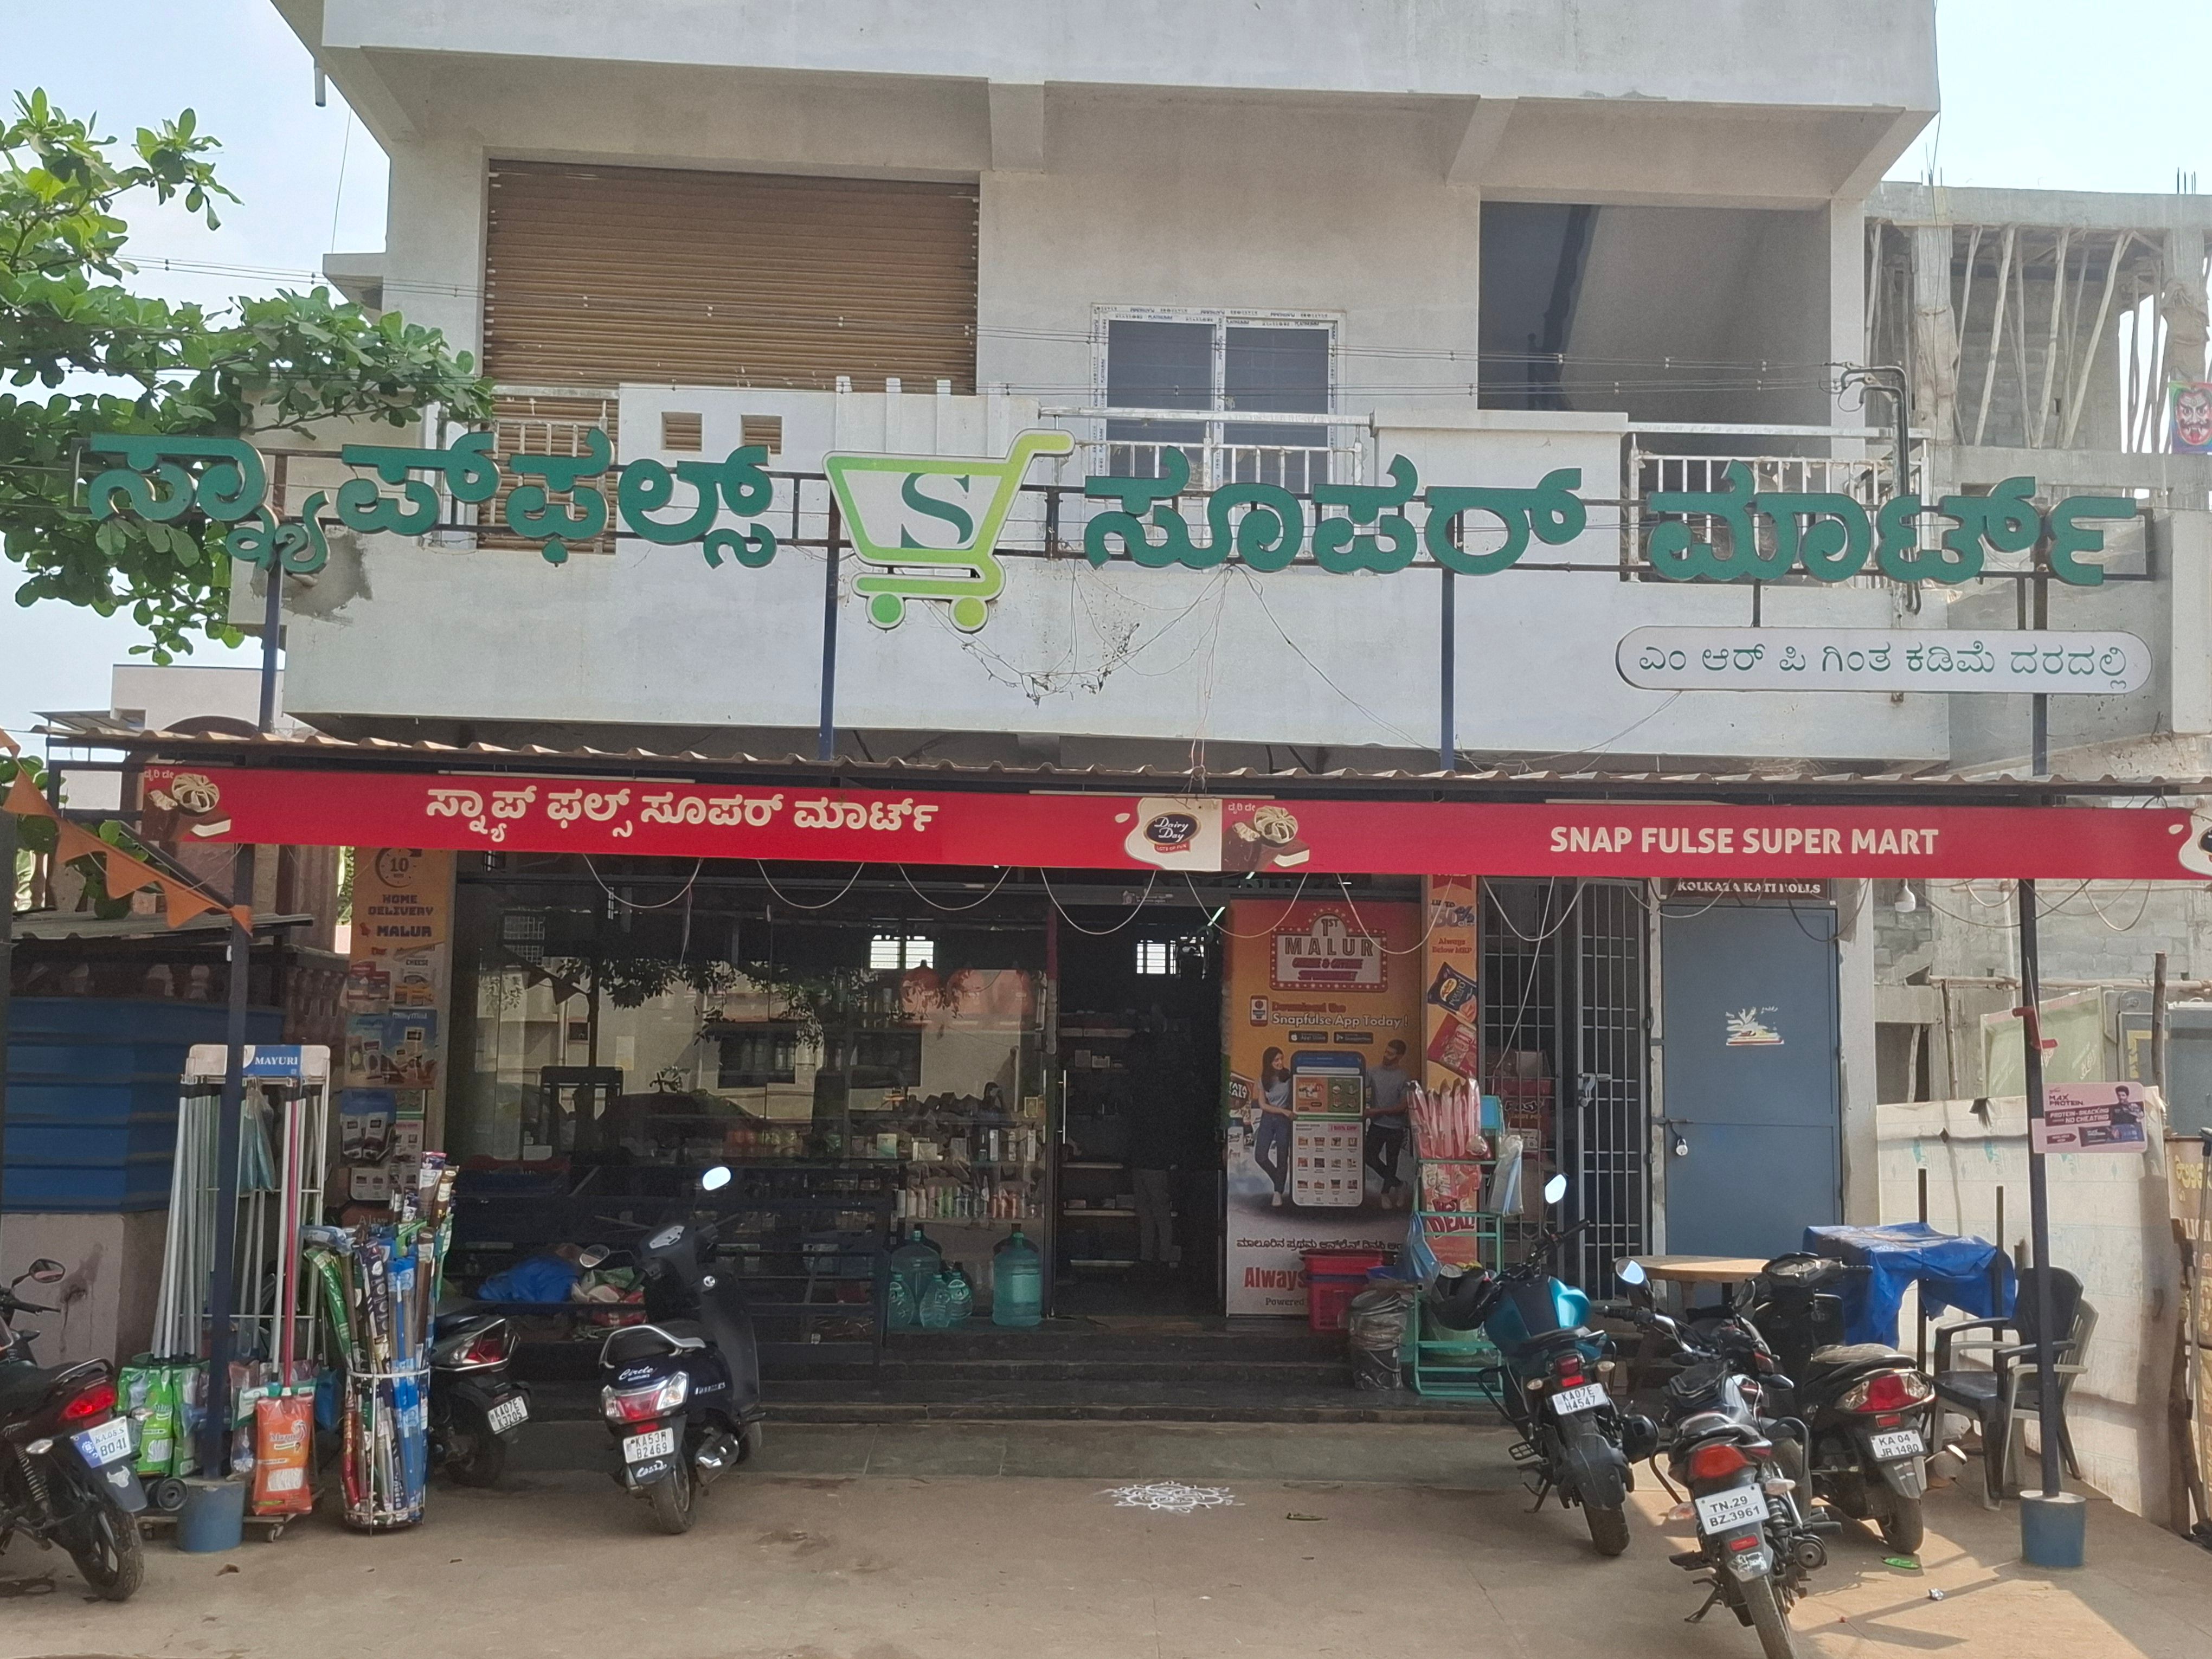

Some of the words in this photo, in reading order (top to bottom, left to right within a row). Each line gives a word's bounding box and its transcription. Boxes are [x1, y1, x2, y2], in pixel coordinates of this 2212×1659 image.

[901, 472, 974, 549] S
[1084, 445, 1587, 575] ಸೂಪರ್
[1647, 459, 2137, 585] ಮಾರ್ಟ್
[1639, 646, 1687, 671] ಎಂ
[1702, 643, 1766, 671] ಆರ್
[1779, 646, 1806, 672] ಪಿ
[1822, 641, 1892, 672] ಗಿಂತ
[1906, 640, 1995, 673] ಕಡಿಮೆ
[2010, 644, 2127, 690] ದರದಲ್ಲಿ
[546, 788, 634, 838] ಫಲ್ಸ್
[640, 792, 785, 827] ಸೂಪರ್
[793, 796, 939, 832] ಮಾರ್ಟ್
[1153, 816, 1189, 832] Dairy
[1158, 827, 1185, 843] Day
[1550, 826, 1632, 853] SNAP
[1641, 827, 1734, 854] FULSE
[1742, 828, 1843, 855] SUPER
[1851, 828, 1939, 856] MART
[390, 857, 409, 872] 10
[382, 895, 418, 904] HOME
[368, 906, 434, 916] DELIVERY
[376, 925, 432, 937] MALUR
[1321, 918, 1339, 937] 1ST
[1284, 937, 1374, 956] MALUR
[1438, 937, 1466, 946] Always
[1271, 1013, 1334, 1028] Snapfulse
[1334, 1014, 1360, 1028] App
[1362, 1015, 1401, 1030] Today
[254, 1056, 298, 1065] MAYURI
[1229, 1089, 1247, 1099] ALT
[1244, 1266, 1307, 1291] Always
[1265, 1297, 1304, 1307] Powered
[1561, 1386, 1594, 1402] KA07E
[494, 1399, 519, 1418] KA07E
[1566, 1395, 1596, 1412] H4547
[100, 1437, 127, 1457] 8041
[1878, 1436, 1896, 1446] KA
[1897, 1434, 1911, 1443] 04
[636, 1442, 667, 1459] B2469
[1880, 1448, 1893, 1457] JR
[1895, 1443, 1919, 1454] 1480
